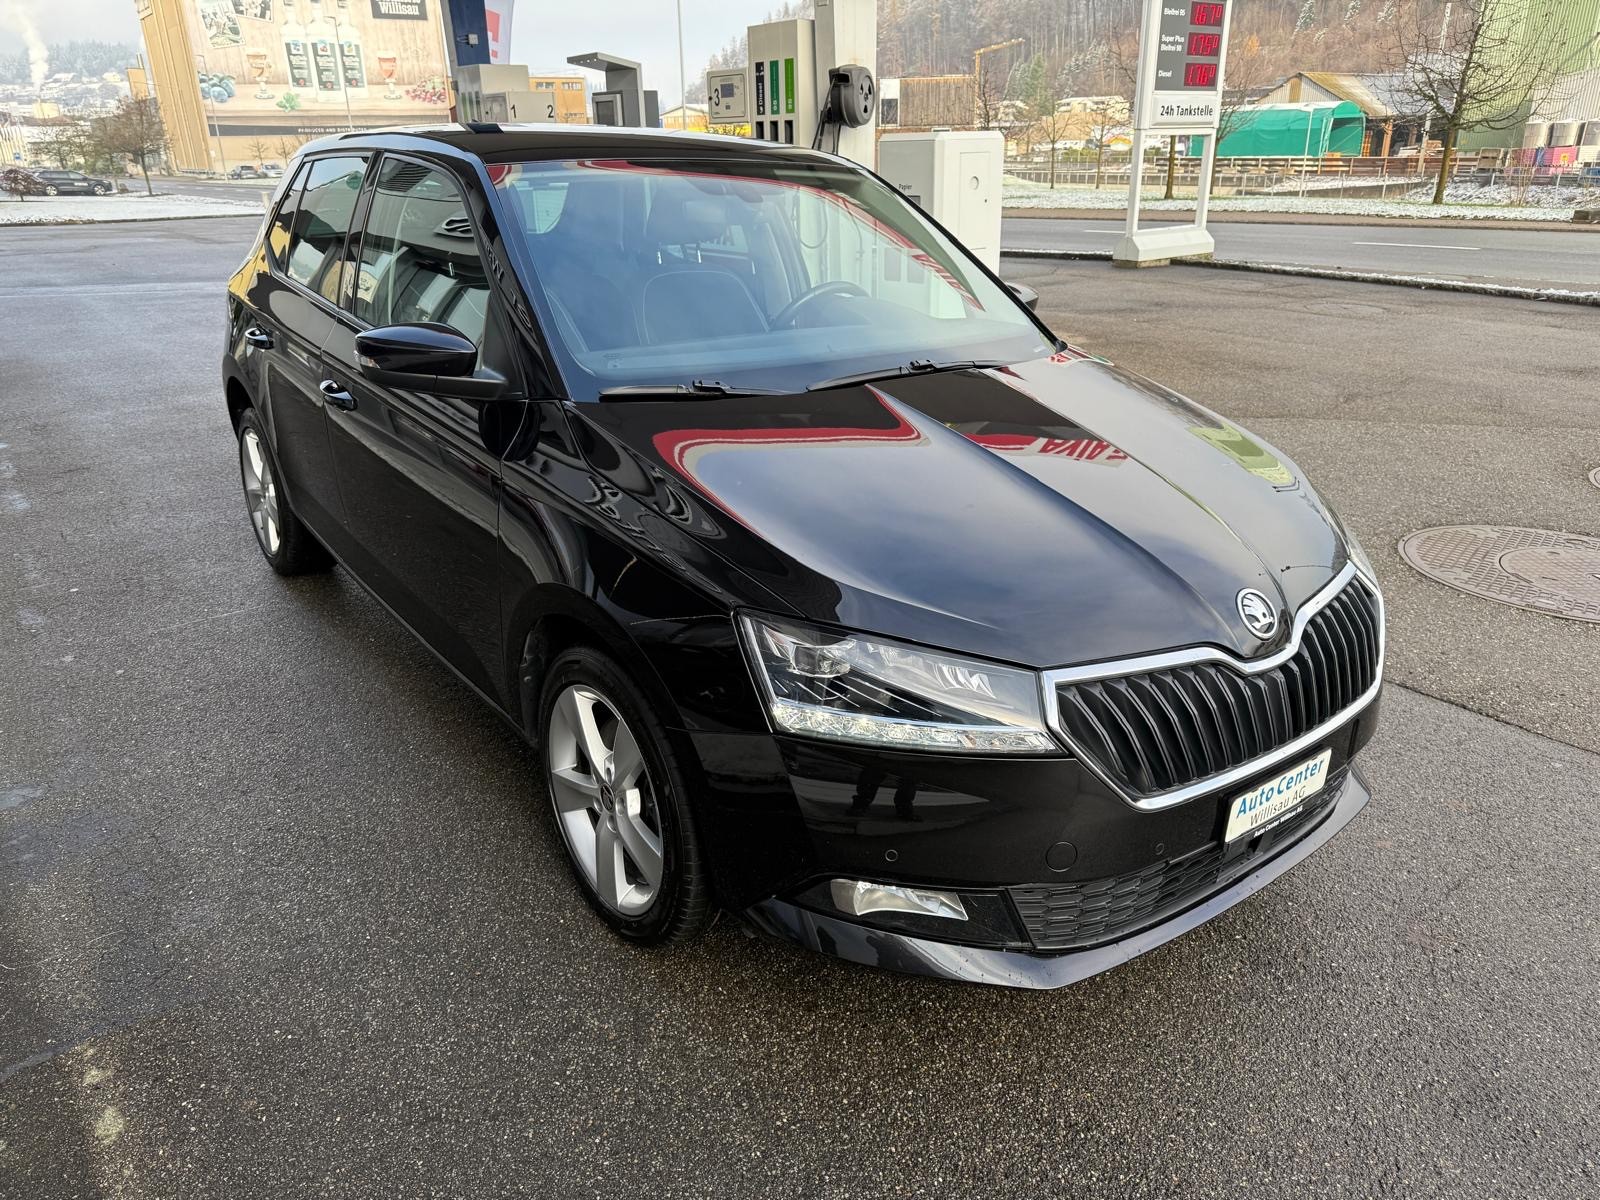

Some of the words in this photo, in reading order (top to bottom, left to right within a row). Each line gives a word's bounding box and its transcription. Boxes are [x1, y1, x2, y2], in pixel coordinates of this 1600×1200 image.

[378, 2, 420, 15] Willisau
[1161, 34, 1175, 43] Super
[1175, 35, 1185, 43] Plus
[1158, 69, 1172, 78] Diesel
[713, 87, 721, 107] 3
[510, 104, 517, 119] 1
[546, 104, 555, 119] 2
[1160, 104, 1175, 116] 24h
[1176, 105, 1214, 117] Tankstelle
[898, 184, 913, 193] Papier
[1250, 798, 1290, 827] Willisau
[1291, 786, 1306, 805] AG
[1253, 827, 1266, 838] Auto
